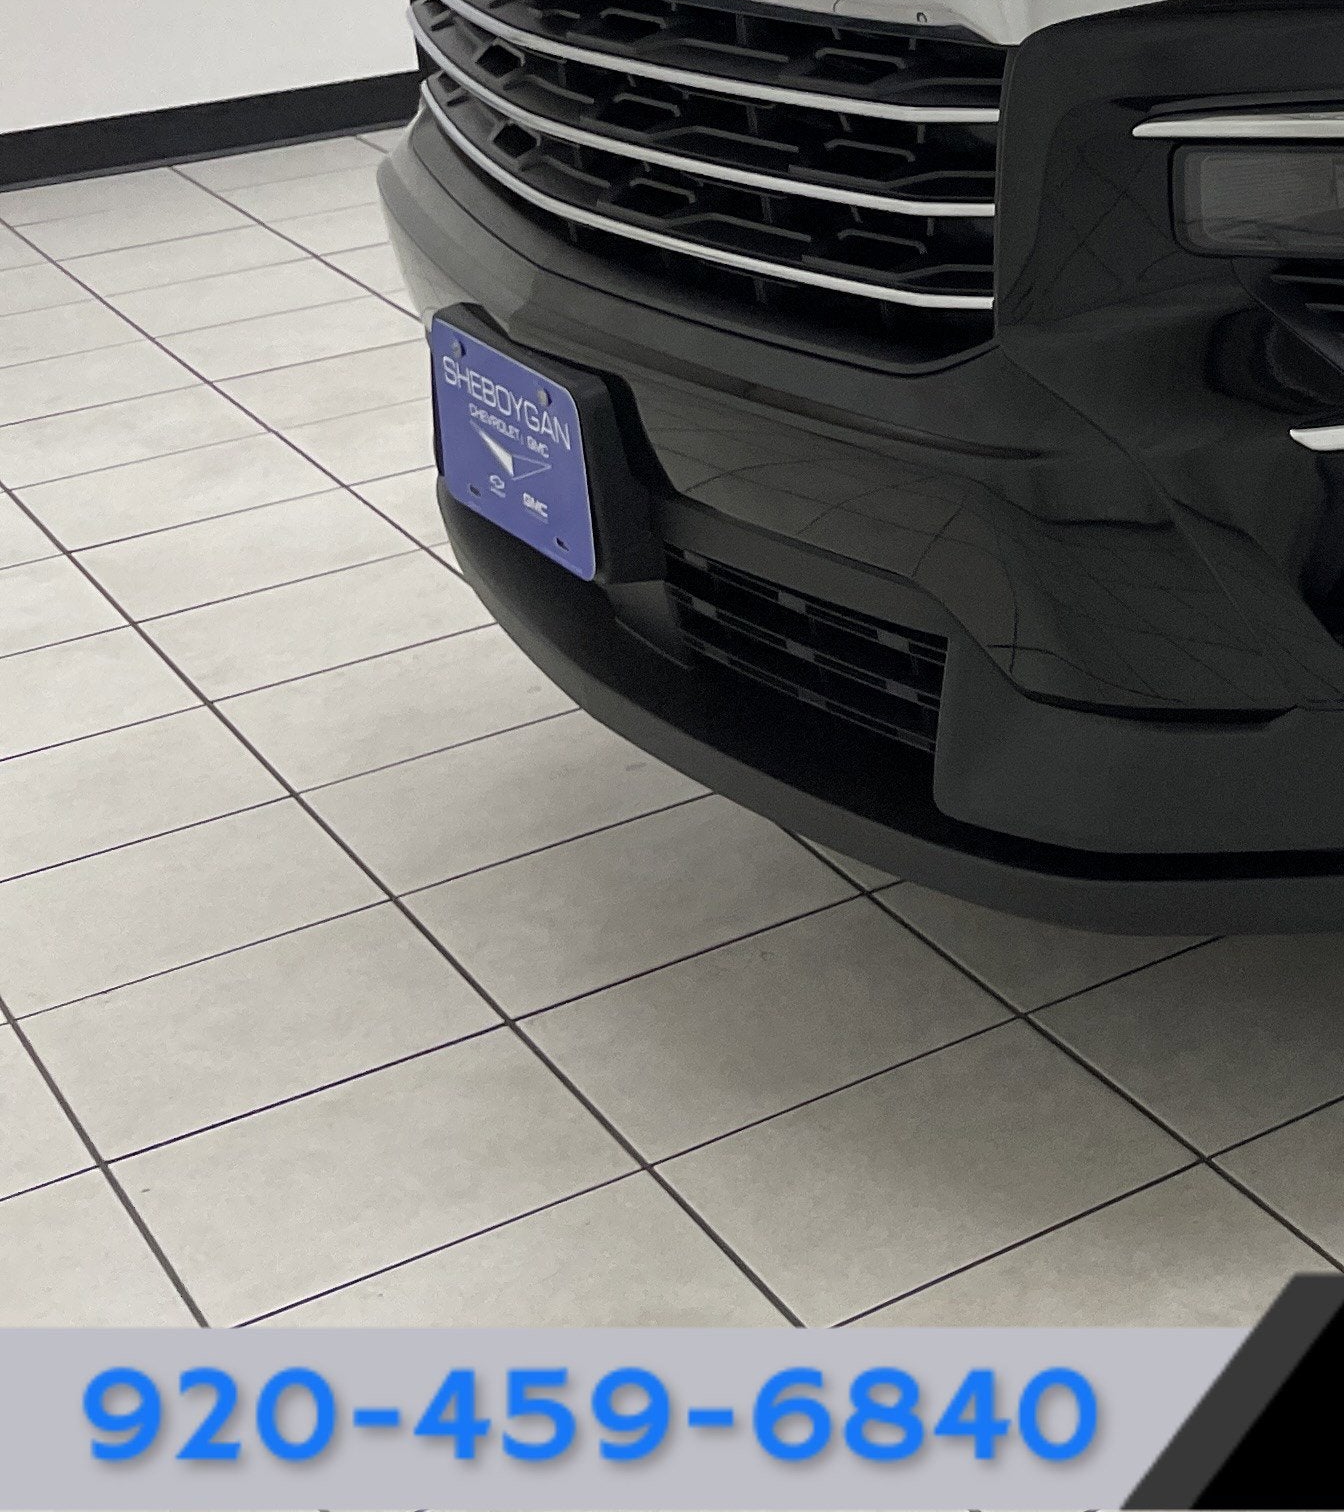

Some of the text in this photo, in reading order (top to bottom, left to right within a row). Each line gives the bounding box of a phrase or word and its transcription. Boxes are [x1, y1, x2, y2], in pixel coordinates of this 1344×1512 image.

[442, 355, 572, 451] SHEBOYGAN
[468, 402, 550, 459] CHEVROLET GMC
[522, 492, 549, 518] GMC
